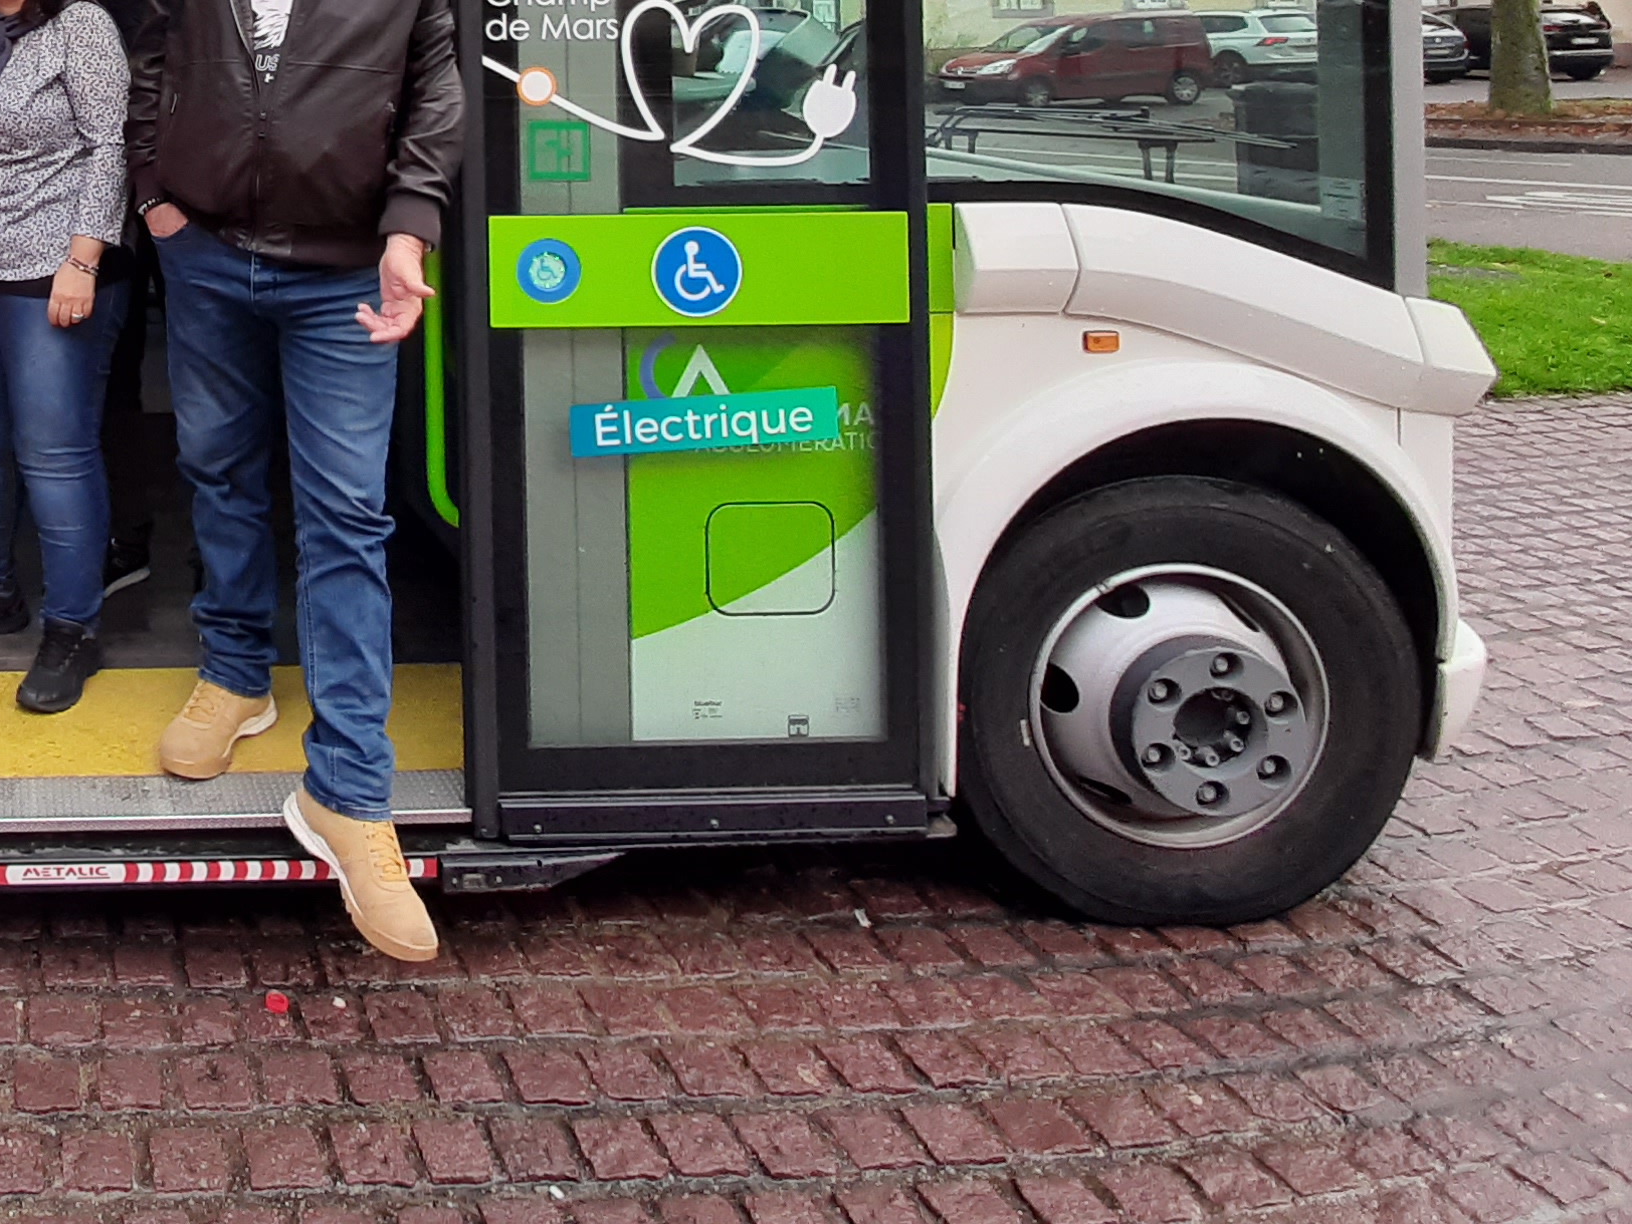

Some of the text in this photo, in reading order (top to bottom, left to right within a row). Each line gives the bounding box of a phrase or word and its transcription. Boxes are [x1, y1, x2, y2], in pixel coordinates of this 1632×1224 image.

[485, 13, 619, 41] de Mars
[594, 404, 814, 447] Électrique
[22, 866, 109, 878] METALIC
